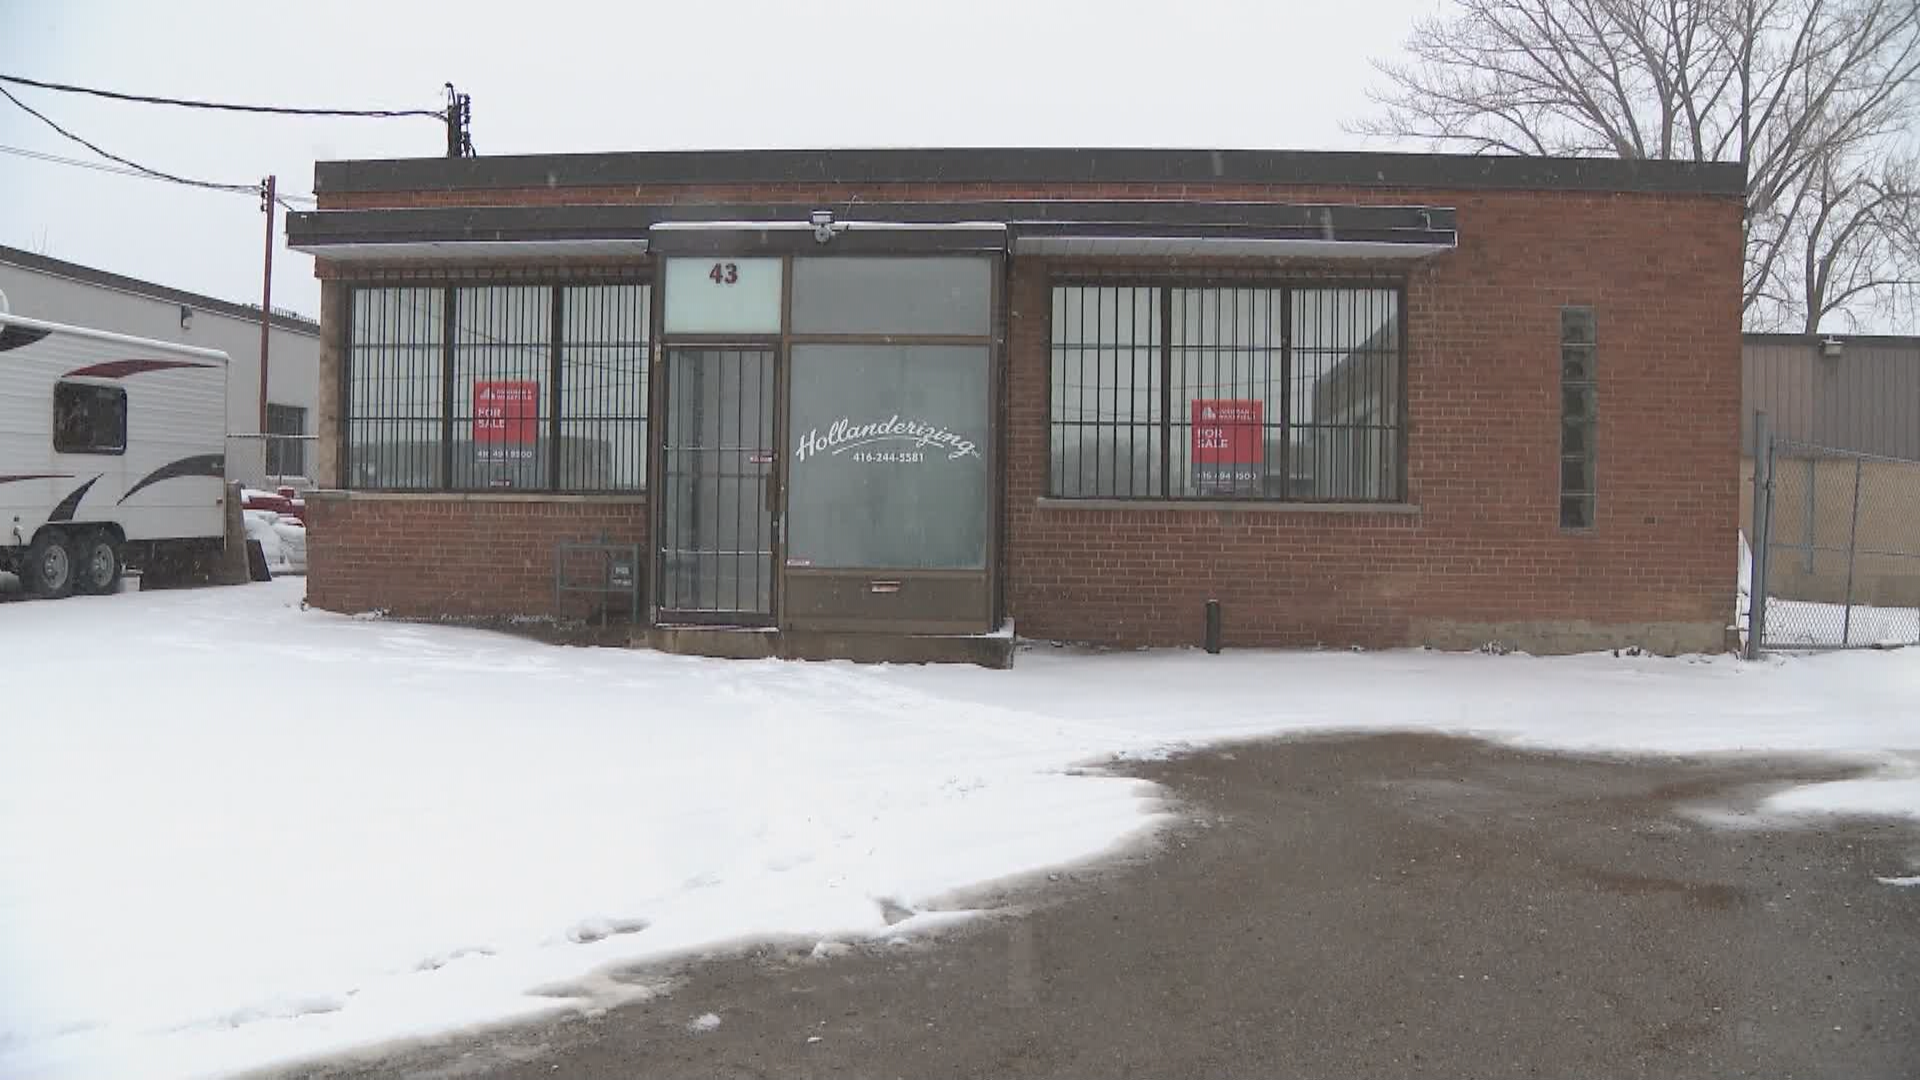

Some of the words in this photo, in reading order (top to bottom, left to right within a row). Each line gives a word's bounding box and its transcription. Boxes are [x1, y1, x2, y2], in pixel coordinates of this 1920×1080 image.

[709, 263, 738, 284] 43
[478, 408, 501, 418] FOR
[478, 419, 505, 428] SALE
[796, 414, 976, 462] Hollanderizing
[1197, 428, 1223, 438] FOR
[1197, 439, 1229, 448] SALE
[853, 452, 924, 463] 416-244-5581
